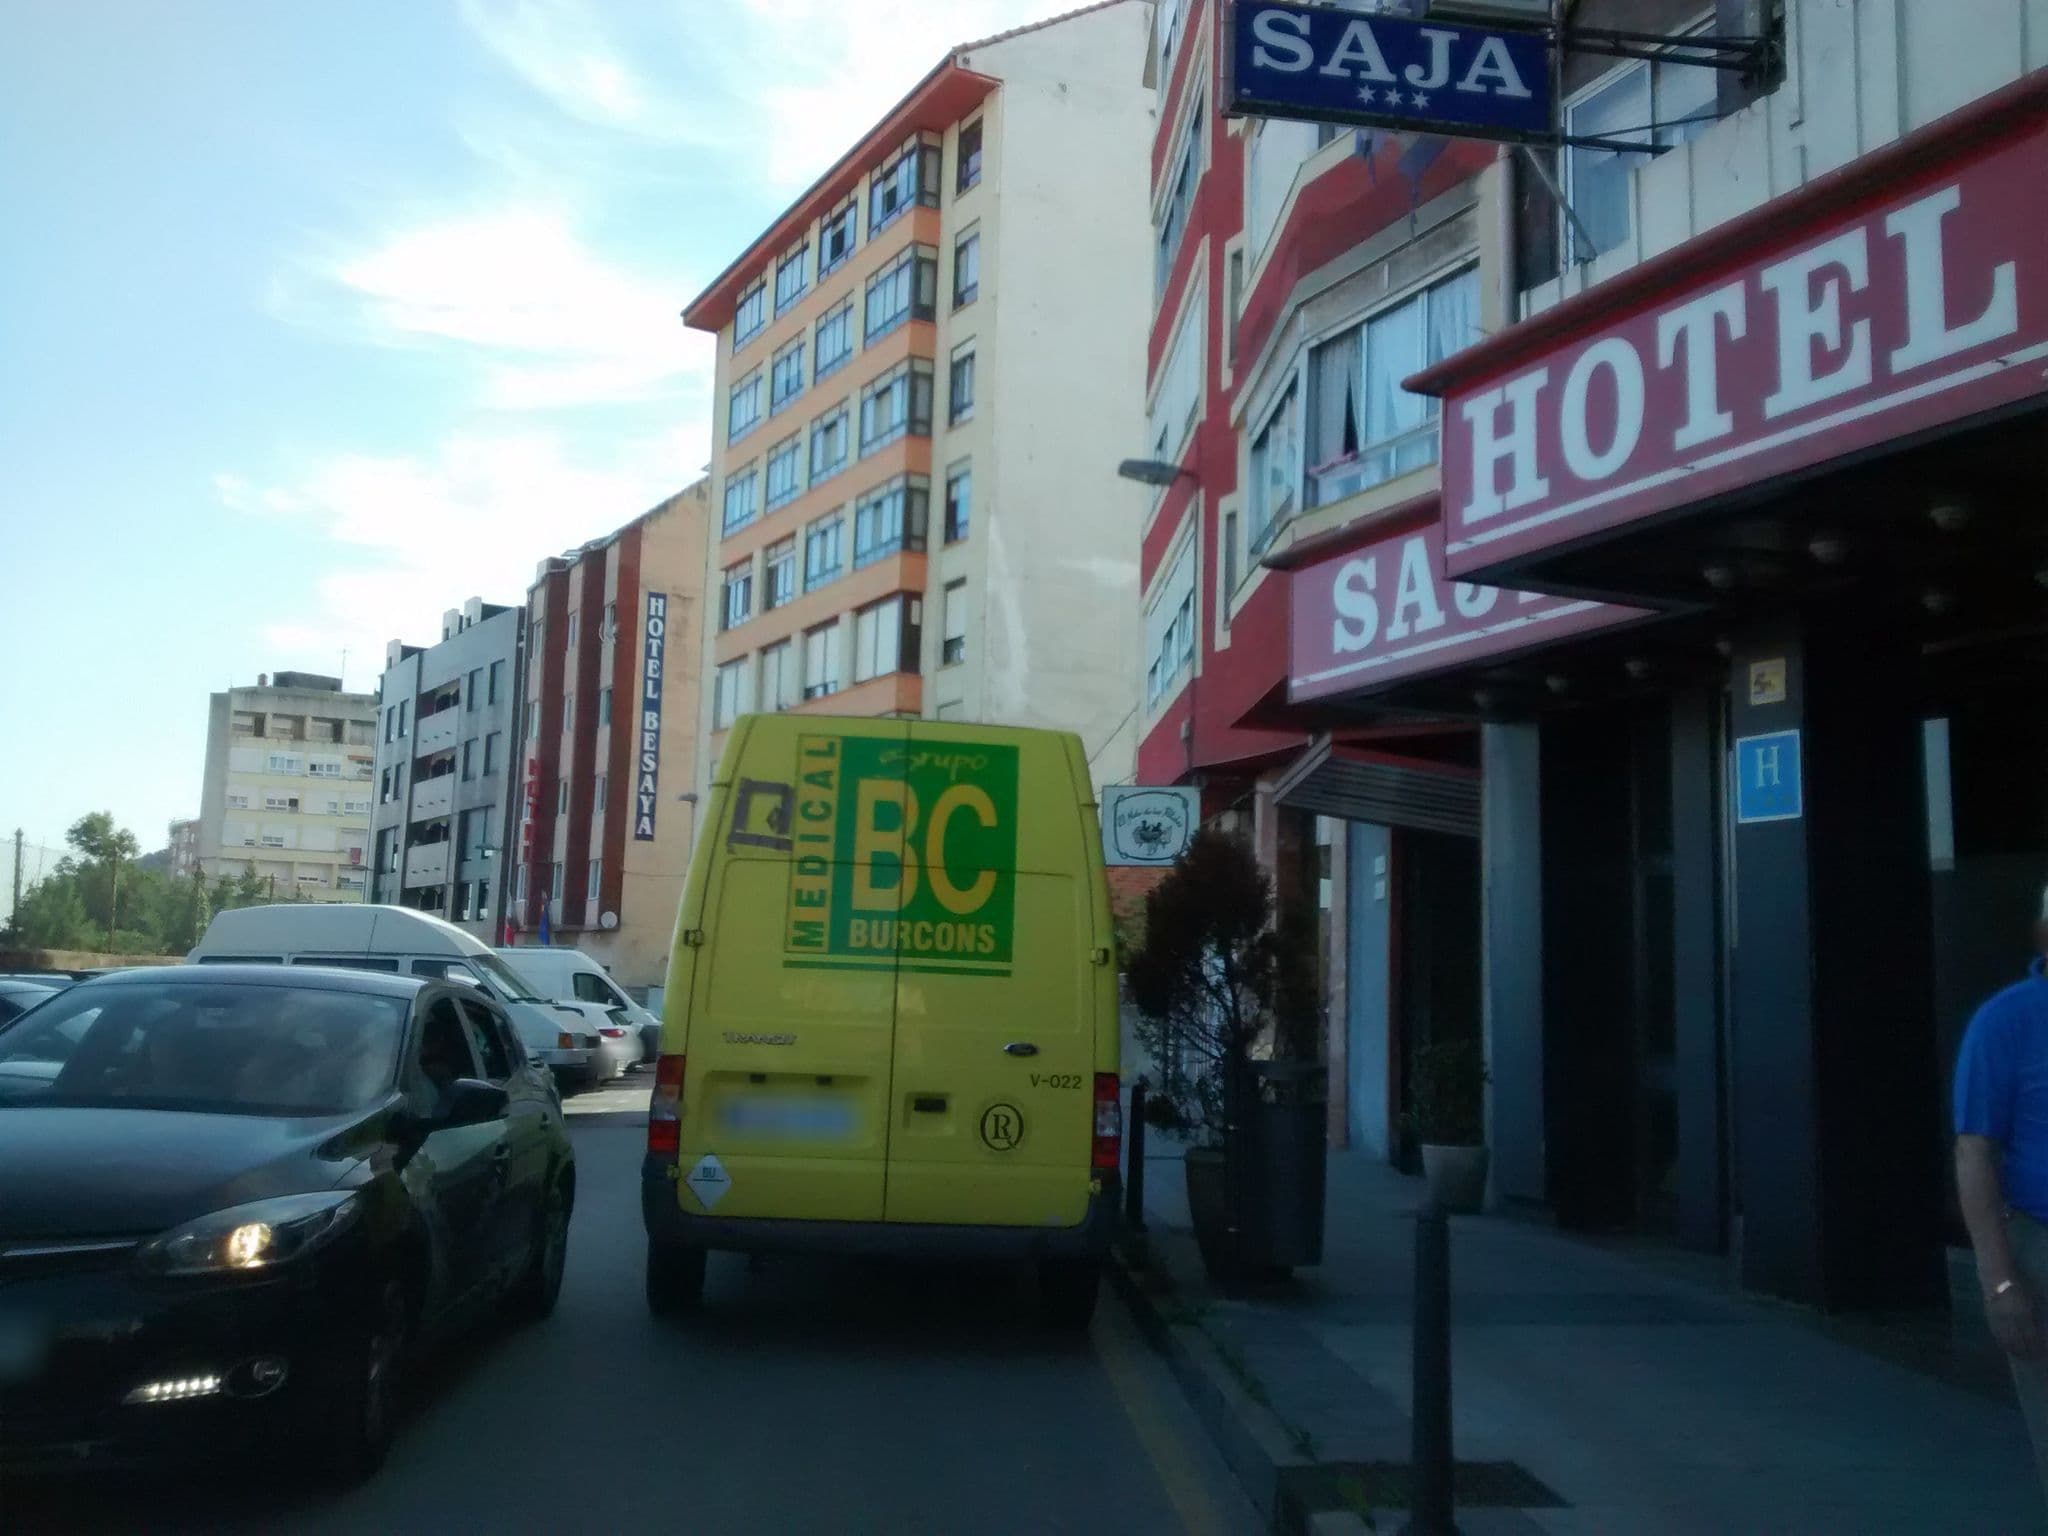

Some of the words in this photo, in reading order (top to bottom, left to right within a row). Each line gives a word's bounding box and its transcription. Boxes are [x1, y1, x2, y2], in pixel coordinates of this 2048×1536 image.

[1252, 8, 1533, 98] SAJA
[1461, 184, 2018, 526] HOTEL
[646, 597, 664, 700] HOTEL
[636, 711, 660, 836] BESAYA
[1755, 745, 1782, 789] H
[791, 741, 837, 949] MEDICAL
[851, 777, 998, 915] BC
[847, 918, 996, 954] BURCONS
[1029, 1073, 1083, 1090] V-022
